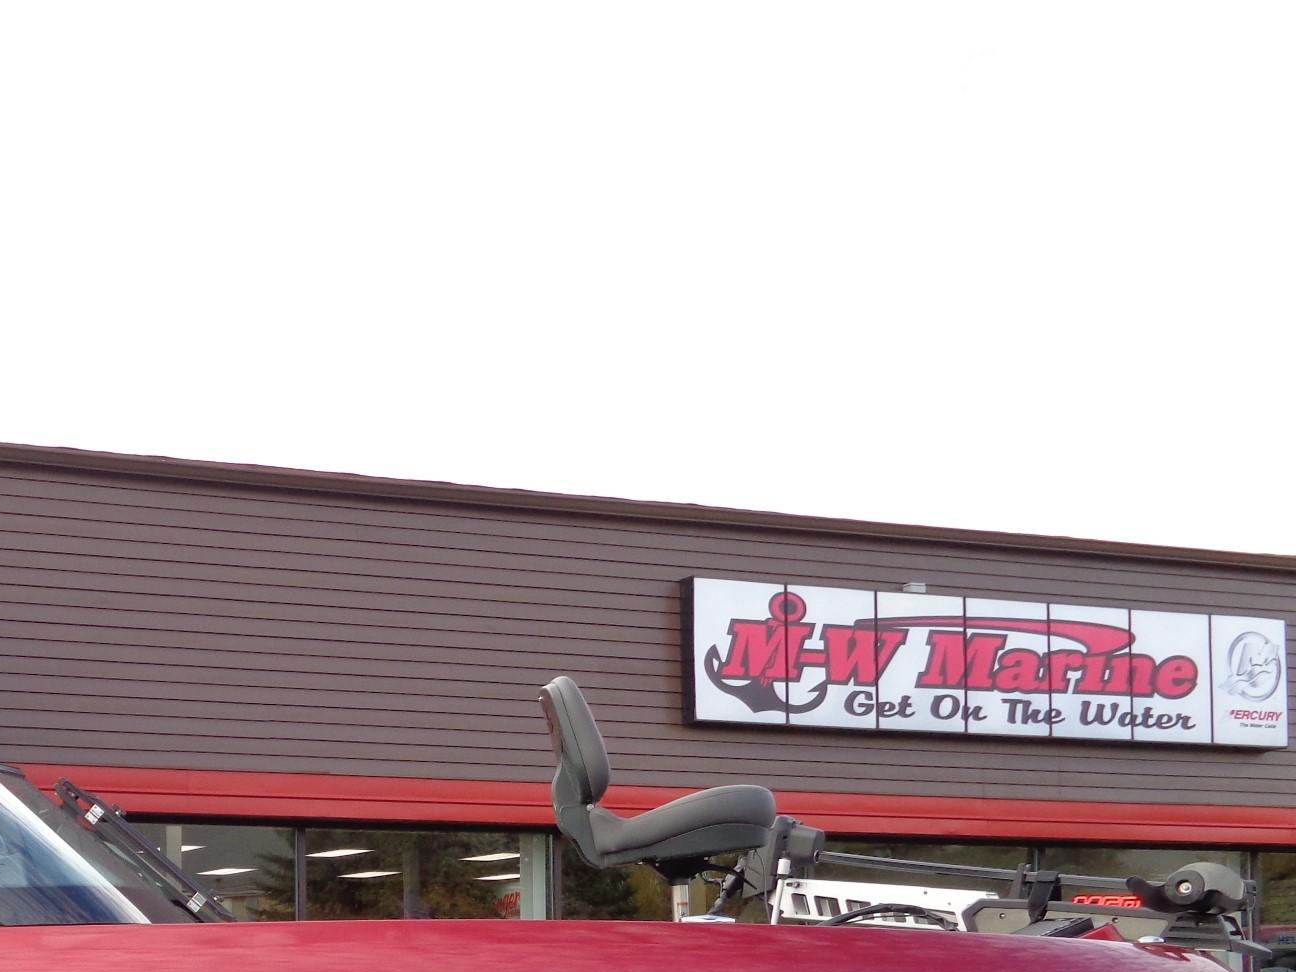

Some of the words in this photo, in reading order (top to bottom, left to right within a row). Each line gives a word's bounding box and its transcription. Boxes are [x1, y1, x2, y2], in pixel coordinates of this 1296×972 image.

[915, 629, 1199, 700] Marine
[844, 691, 916, 719] Get
[930, 693, 988, 723] On
[1001, 698, 1066, 725] The
[1079, 700, 1197, 731] Water
[1227, 709, 1282, 721] ERCURY
